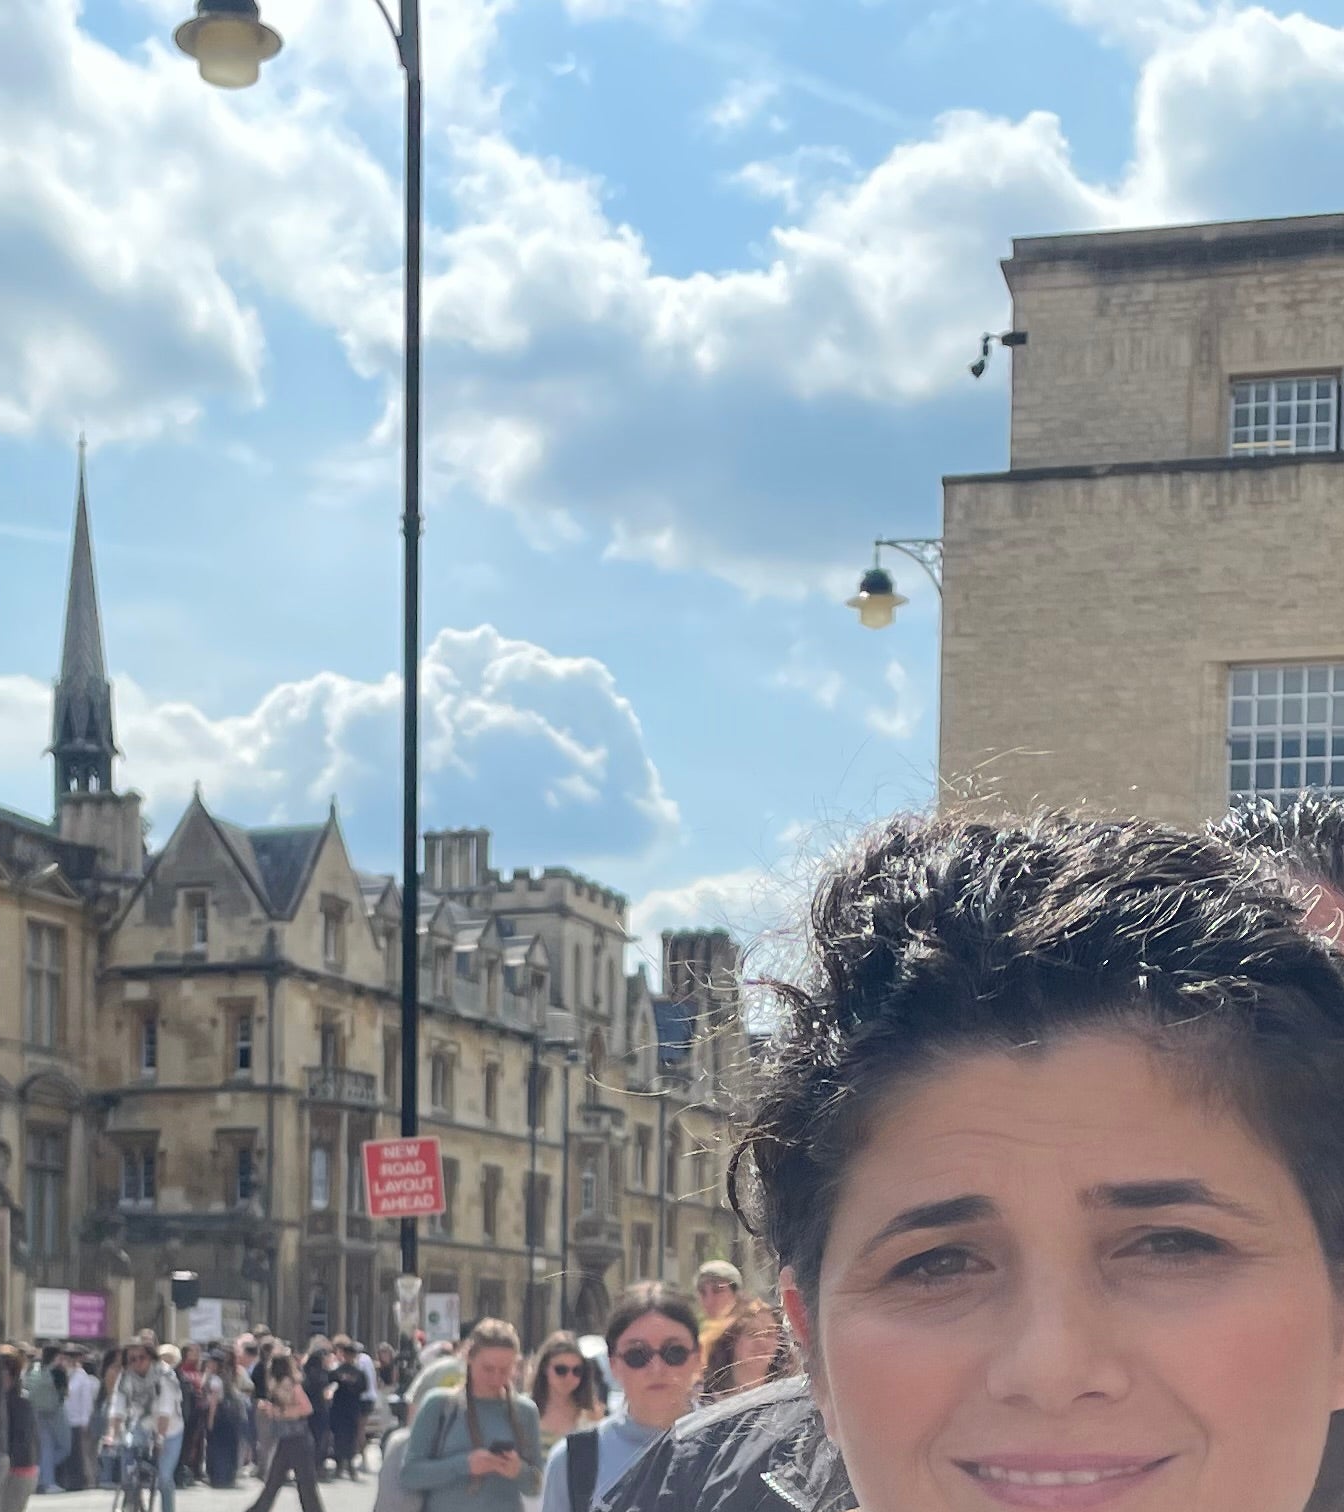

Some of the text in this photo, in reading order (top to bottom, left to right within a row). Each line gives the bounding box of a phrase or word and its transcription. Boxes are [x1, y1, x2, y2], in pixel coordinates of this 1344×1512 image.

[382, 1144, 420, 1157] NEW
[380, 1160, 427, 1176] ROAD
[374, 1177, 434, 1195] LAYOUT
[381, 1194, 434, 1211] AHEAD
